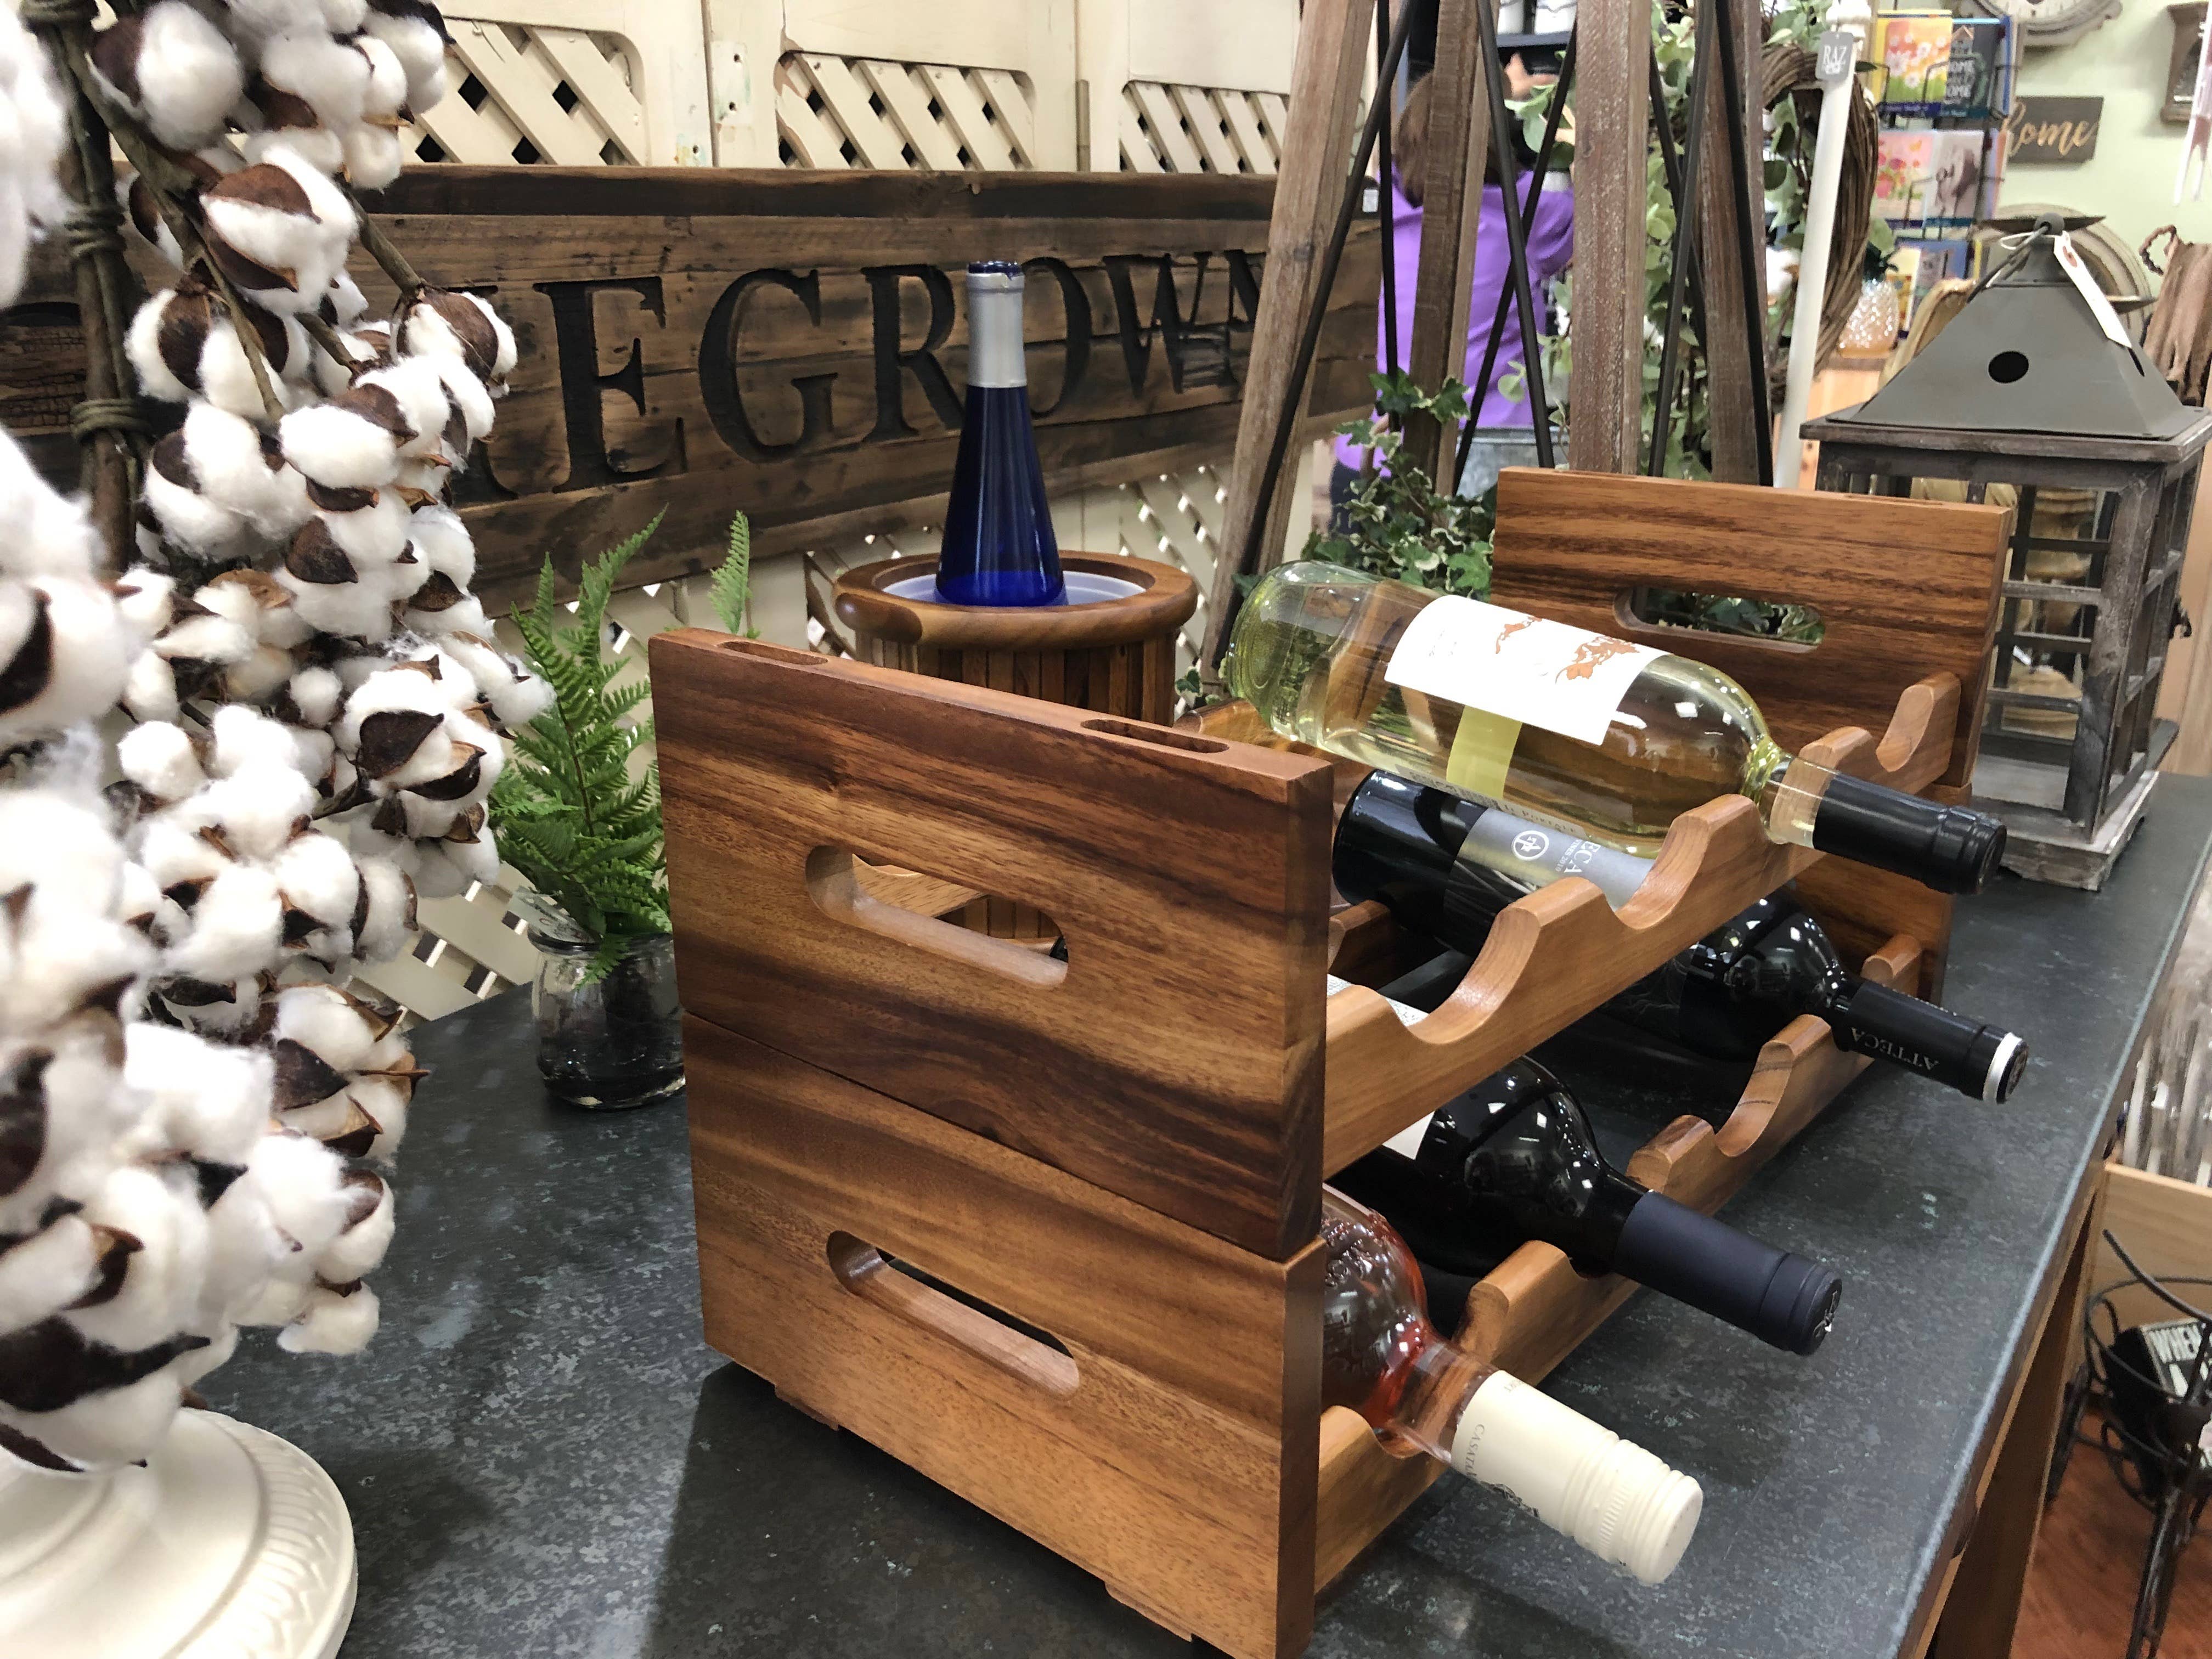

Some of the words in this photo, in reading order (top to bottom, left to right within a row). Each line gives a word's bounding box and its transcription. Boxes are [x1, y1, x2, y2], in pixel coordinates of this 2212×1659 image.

[1823, 46, 1847, 64] RAZ
[447, 250, 1267, 500] EGROWN
[1850, 1026, 1939, 1070] ATTECA
